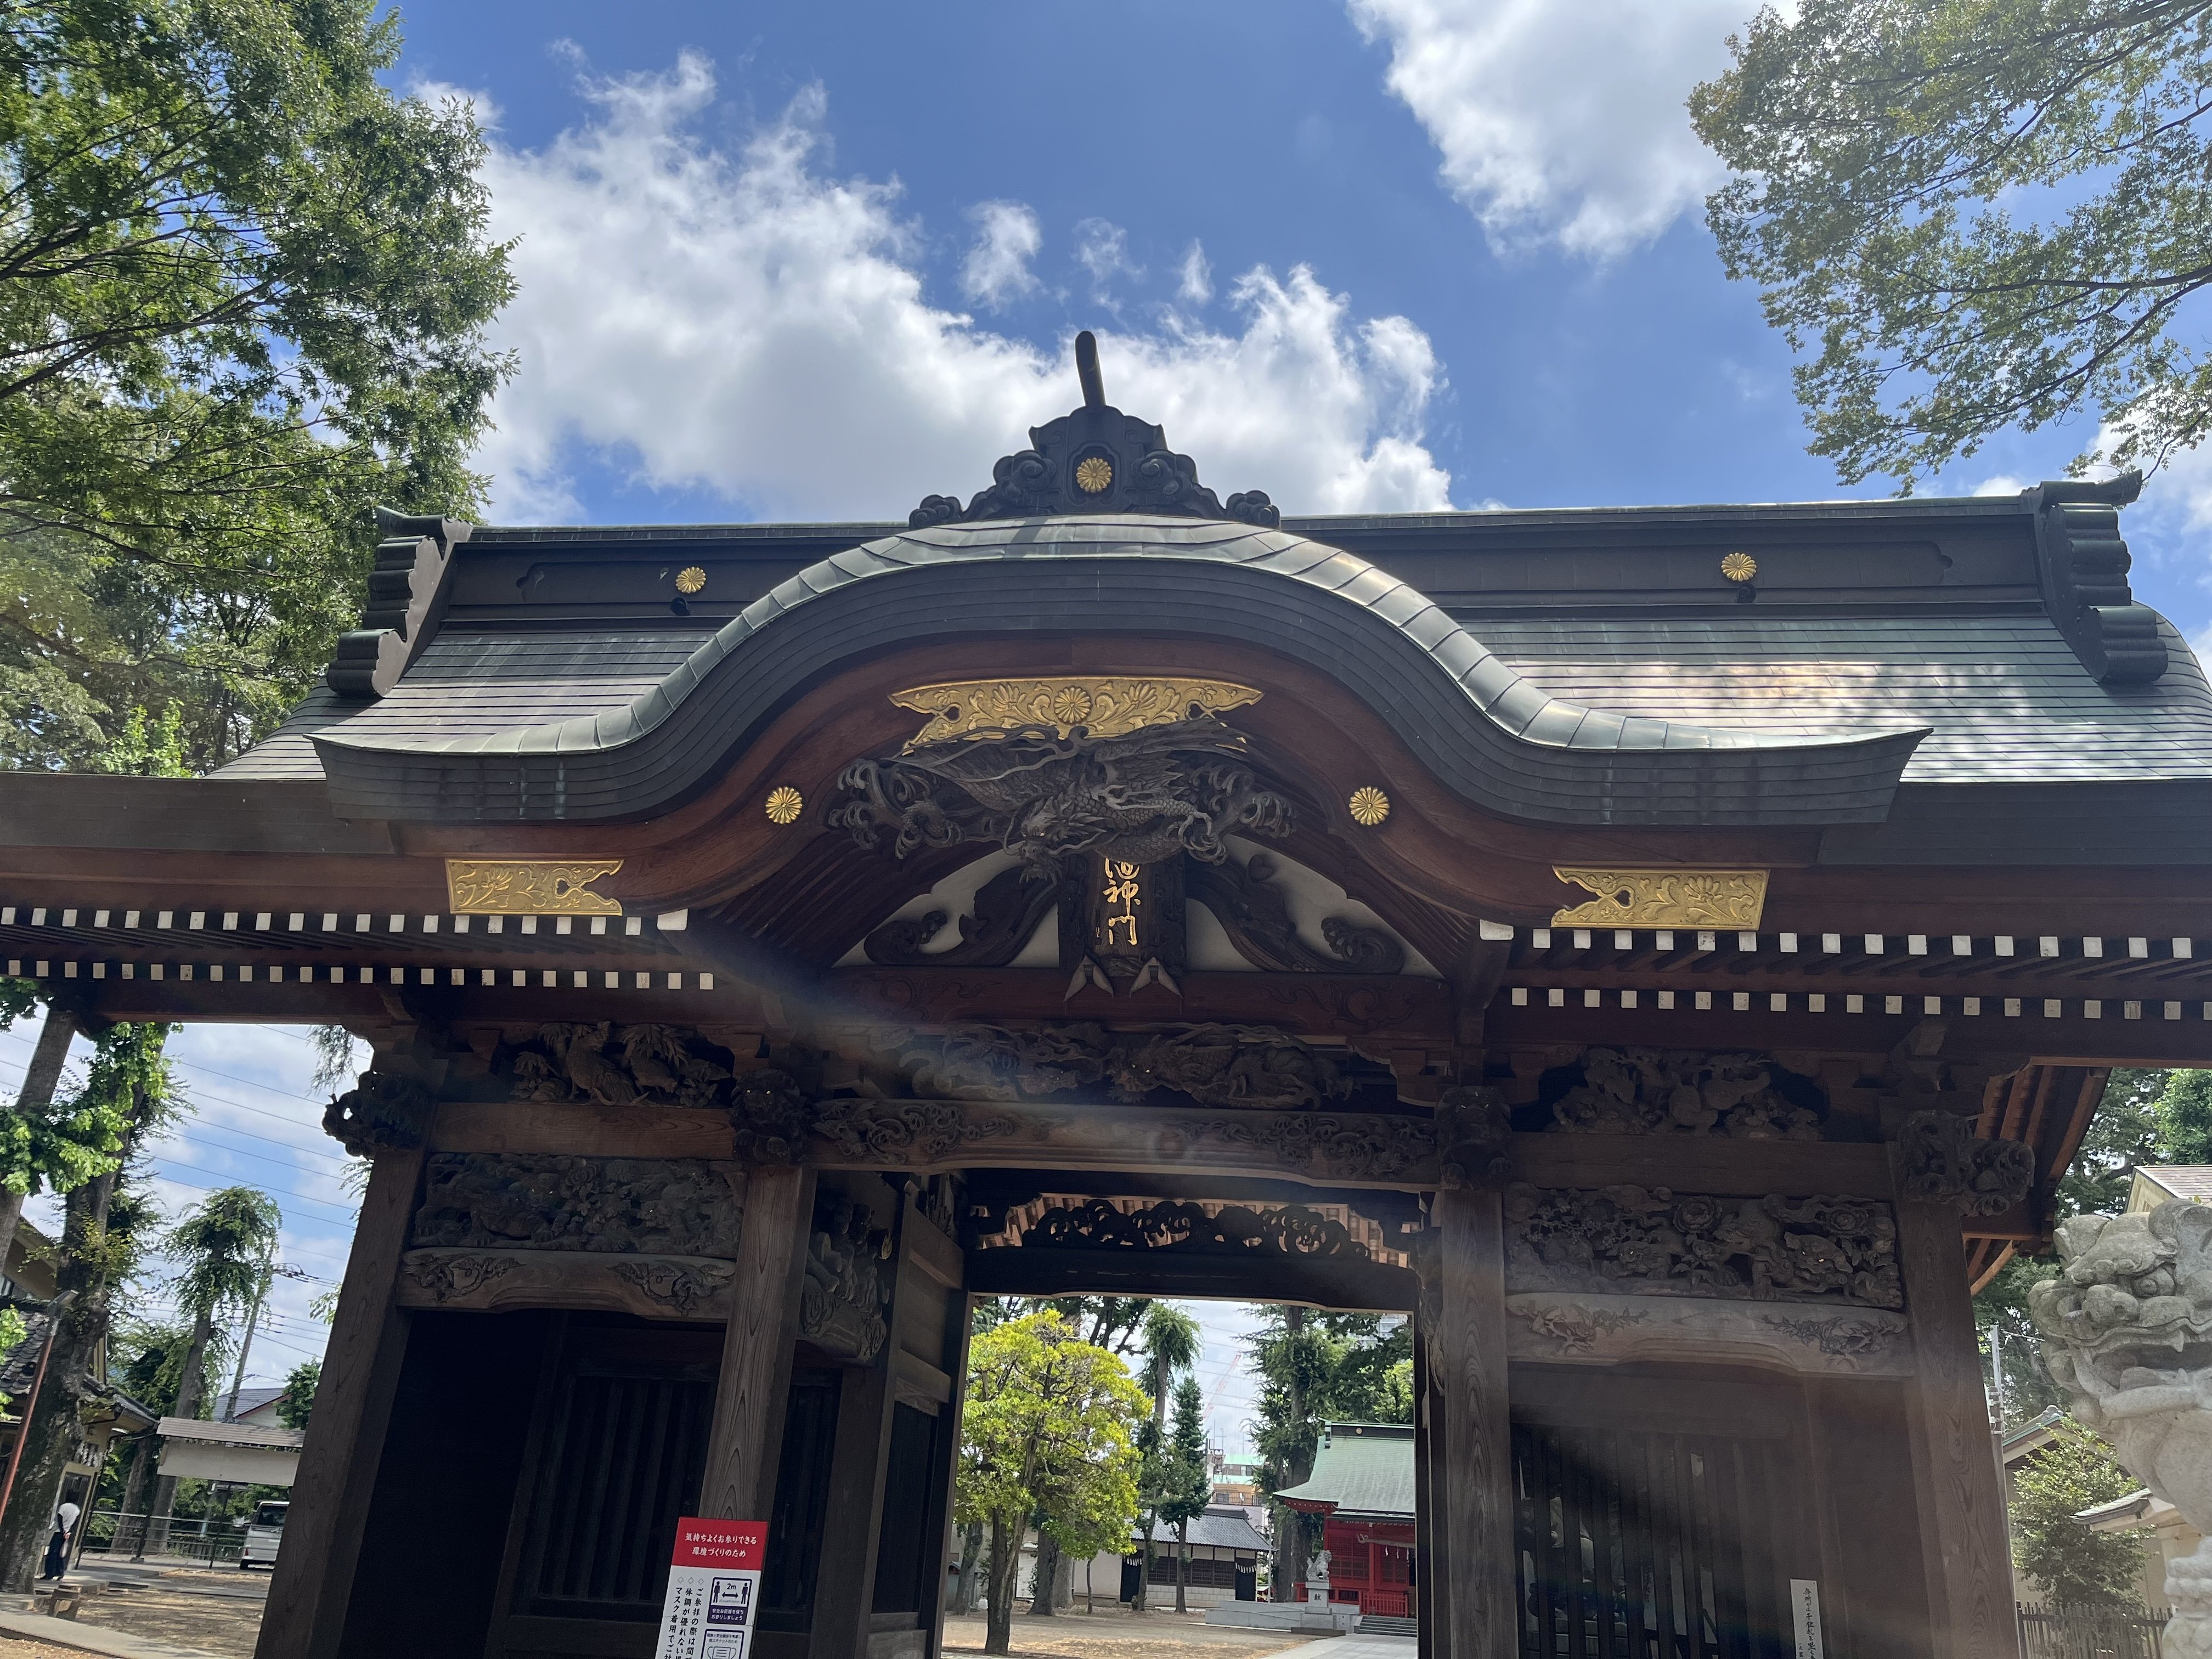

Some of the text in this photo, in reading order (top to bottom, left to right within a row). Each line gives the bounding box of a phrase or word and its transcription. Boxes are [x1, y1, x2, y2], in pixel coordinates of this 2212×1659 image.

[685, 1532, 757, 1545] 気持ちよくお参りできる
[692, 1547, 746, 1558] 環境づくりのため
[685, 1588, 704, 1659] ご参拝の際は間
